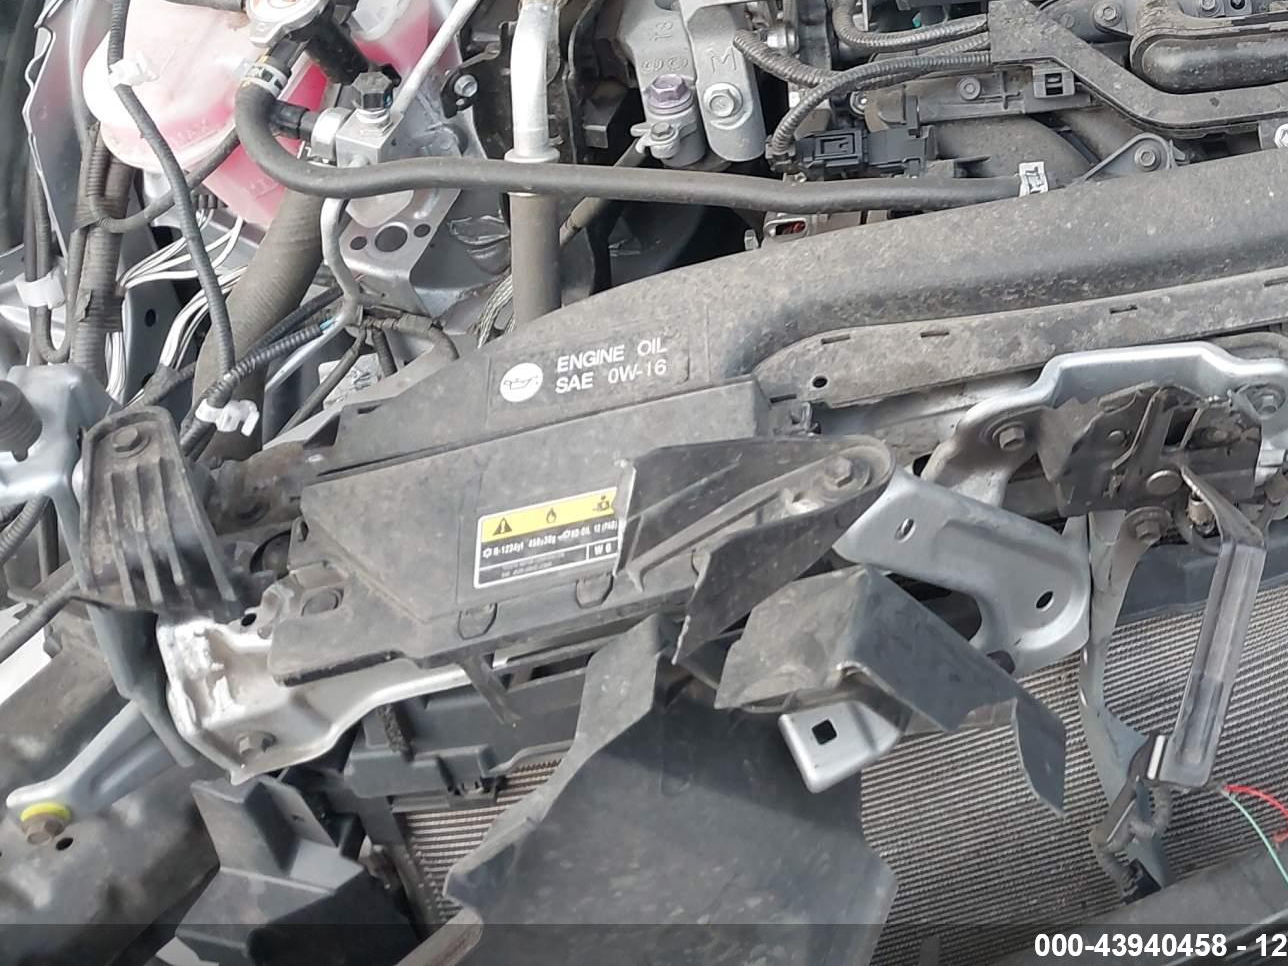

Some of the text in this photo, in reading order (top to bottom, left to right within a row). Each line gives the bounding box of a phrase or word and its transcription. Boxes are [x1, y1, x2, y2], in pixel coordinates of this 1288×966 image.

[557, 337, 667, 373] ENGINE OIL
[555, 359, 667, 393] SAE 0W-16
